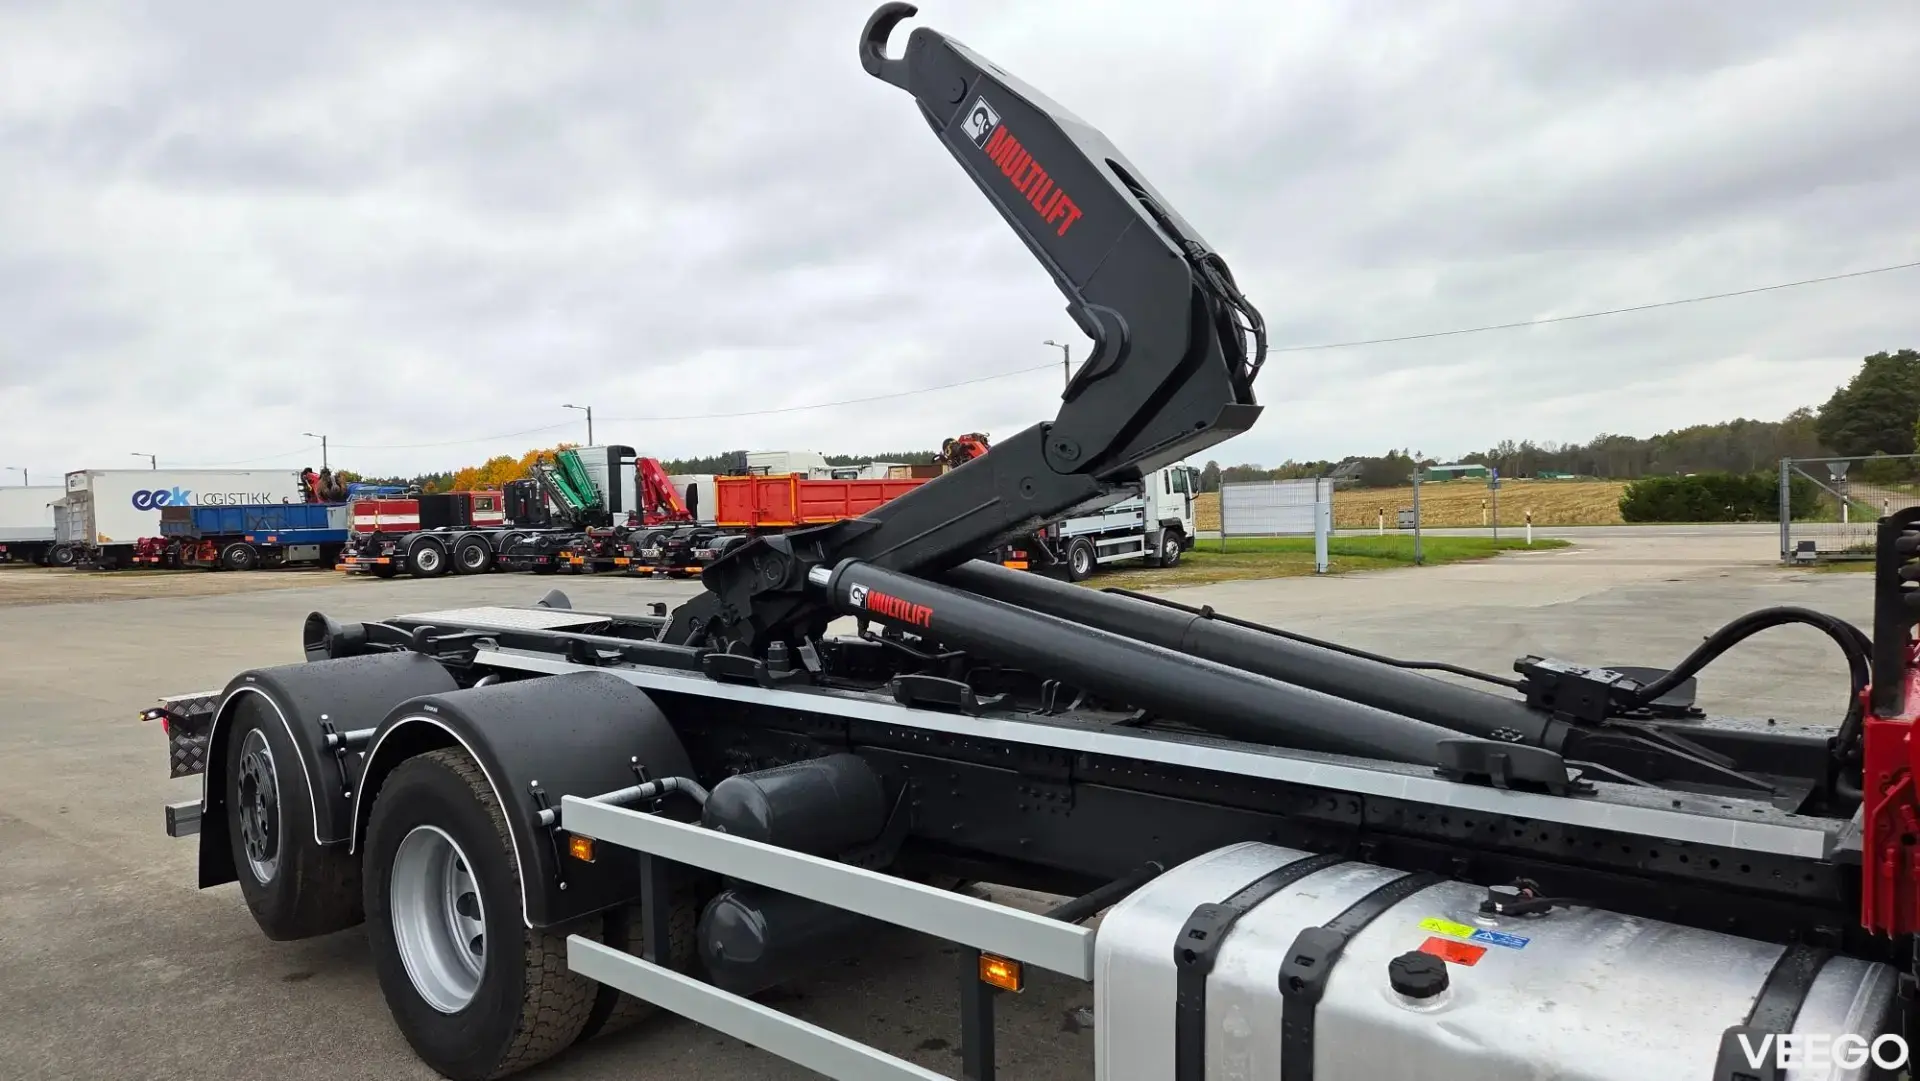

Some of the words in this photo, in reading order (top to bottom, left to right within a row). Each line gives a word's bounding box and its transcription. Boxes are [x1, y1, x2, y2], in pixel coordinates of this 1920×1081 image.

[984, 124, 1083, 237] MULTILIFT
[132, 486, 192, 511] eek
[195, 492, 272, 506] LOGISTIKK
[867, 590, 934, 628] MULTILIFT
